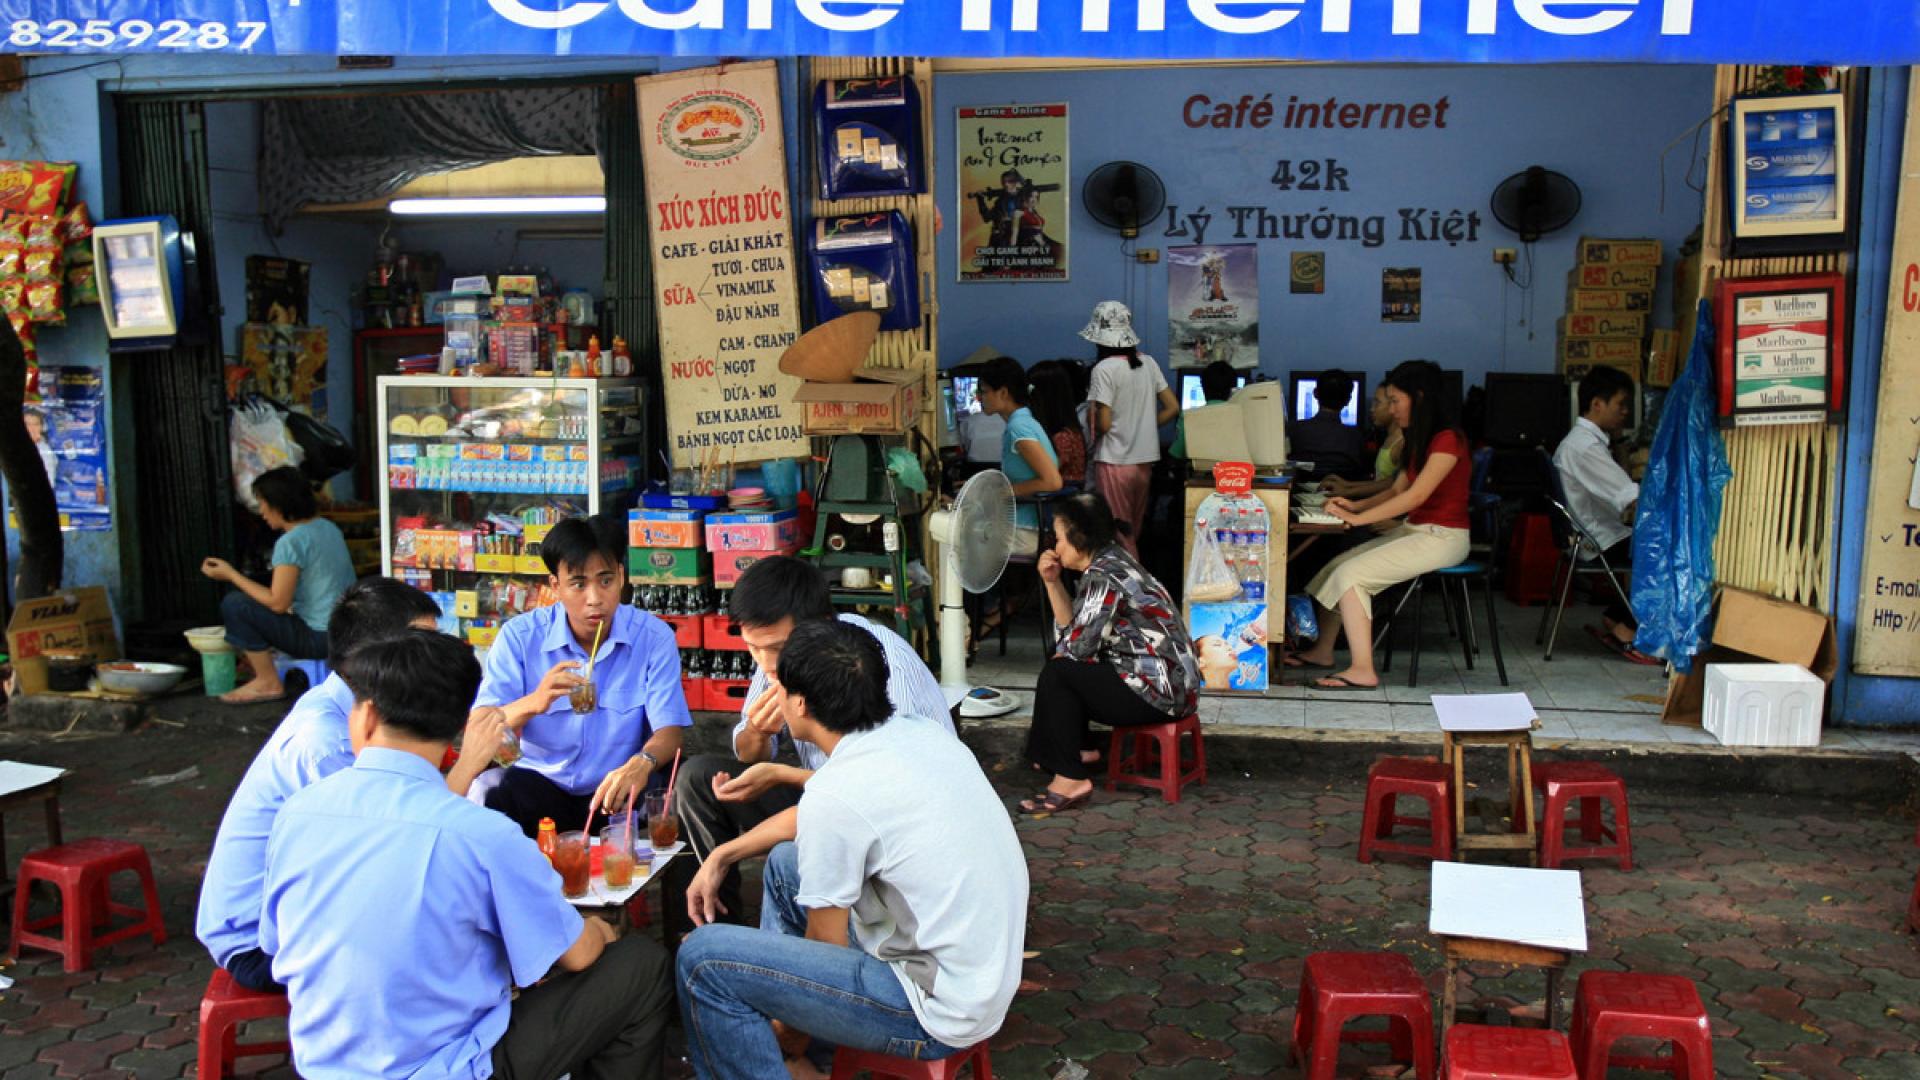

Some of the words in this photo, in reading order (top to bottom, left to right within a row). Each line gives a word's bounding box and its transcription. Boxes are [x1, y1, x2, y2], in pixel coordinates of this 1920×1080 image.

[8, 19, 267, 50] 8259287
[1183, 93, 1274, 129] Café
[1283, 95, 1450, 129] internet
[1270, 158, 1350, 192] 42k
[658, 193, 694, 231] XÚC
[698, 190, 741, 227] XÍCH
[744, 185, 783, 222] ĐỨC
[1163, 206, 1212, 244] Lý
[1397, 208, 1482, 246] Kiệt
[662, 243, 698, 259] CAFE
[712, 260, 742, 277] TƯƠI
[751, 257, 785, 273] CHUA
[663, 283, 696, 306] SỮA
[716, 279, 776, 298] VINAMILK
[1903, 263, 1920, 312] C
[716, 303, 741, 325] ĐẬU
[745, 301, 780, 319] NÀNH
[1774, 296, 1817, 311] Marlboro
[719, 336, 745, 351] CAM
[754, 332, 796, 348] CHANH
[1756, 336, 1807, 348] Marlboro
[671, 354, 715, 379] NƯỚC
[723, 359, 756, 378] NGỌT
[1773, 353, 1815, 366] Marlboro
[1759, 390, 1802, 404] Marlboro
[696, 410, 721, 426] KEM
[724, 404, 781, 423] KARAMEL
[677, 430, 710, 449] BÁNH
[713, 430, 745, 448] NGỌT
[748, 424, 772, 442] CÁC
